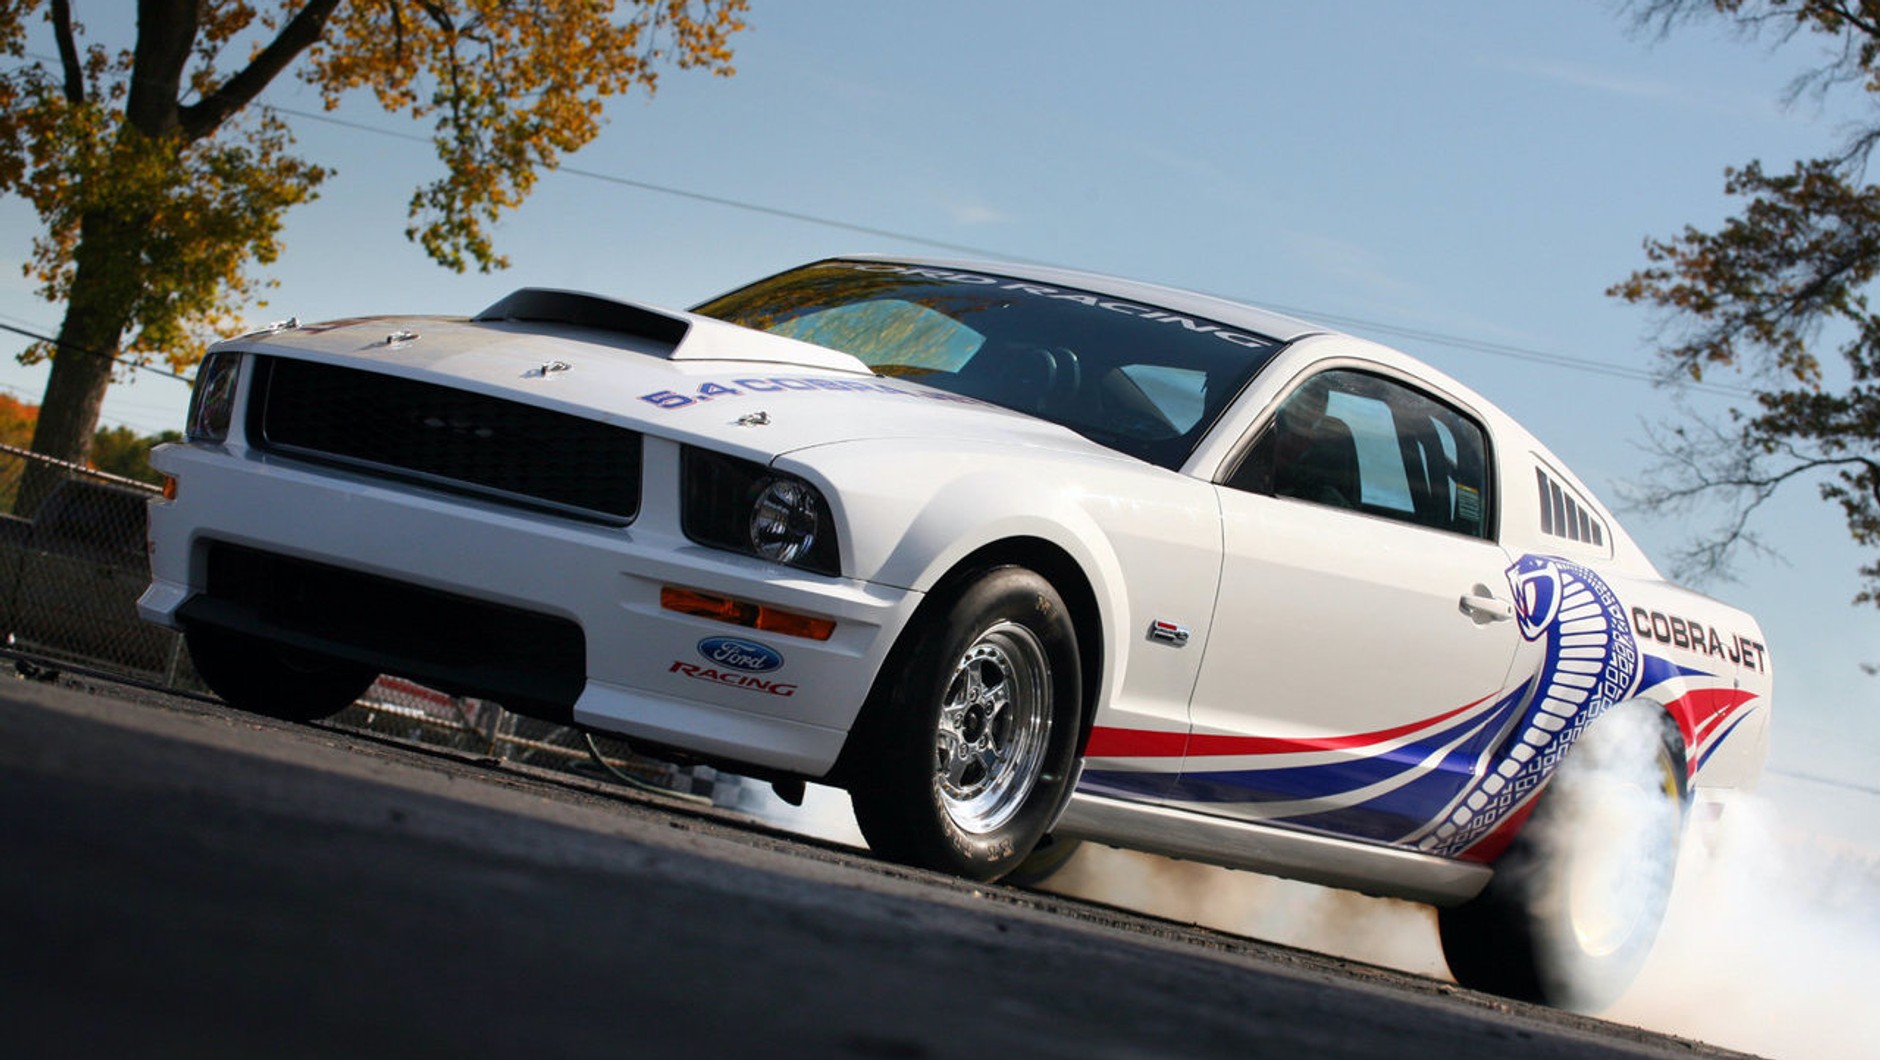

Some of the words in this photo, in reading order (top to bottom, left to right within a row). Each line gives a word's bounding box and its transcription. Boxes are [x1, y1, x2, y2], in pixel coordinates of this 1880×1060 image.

[1000, 282, 1271, 349] RACING
[637, 377, 740, 410] 5.4
[712, 641, 768, 670] Ford
[1631, 605, 1726, 660] COBRA
[1728, 632, 1766, 673] JET
[668, 660, 798, 697] RACING
